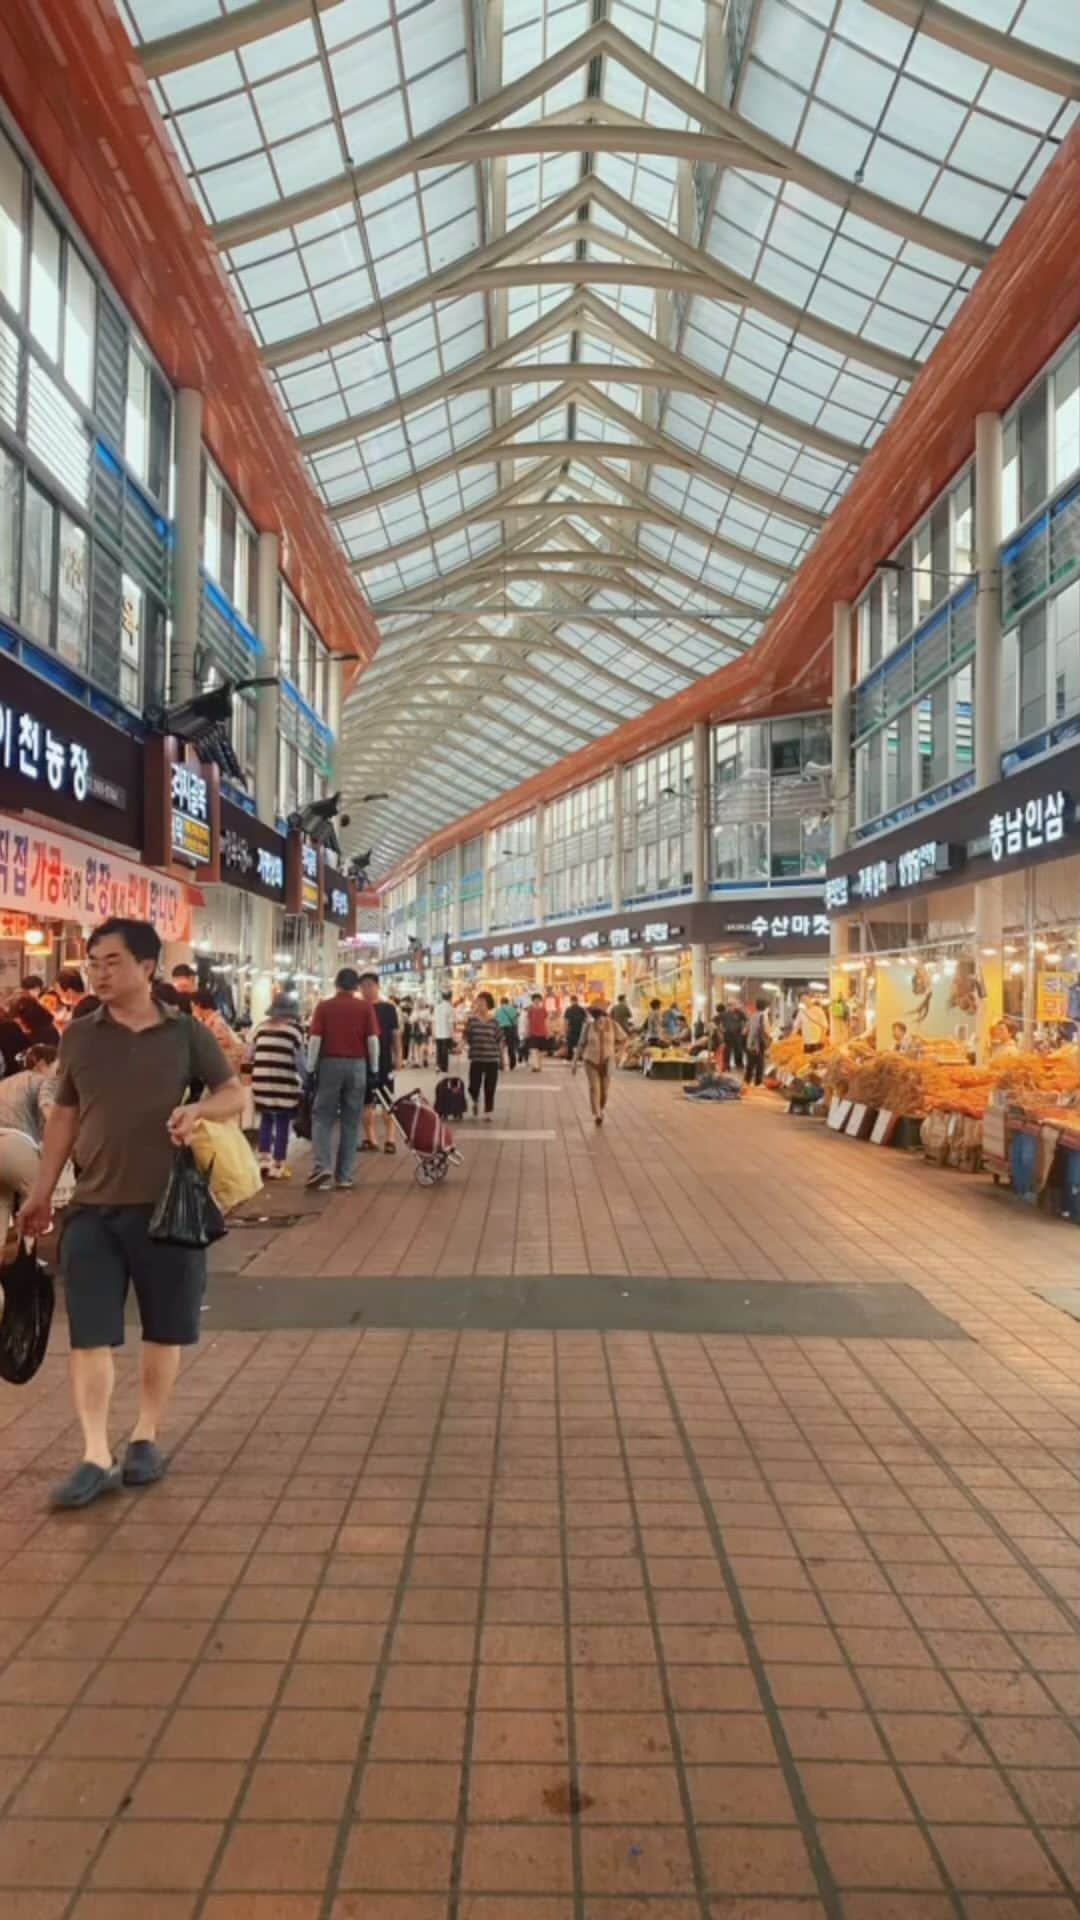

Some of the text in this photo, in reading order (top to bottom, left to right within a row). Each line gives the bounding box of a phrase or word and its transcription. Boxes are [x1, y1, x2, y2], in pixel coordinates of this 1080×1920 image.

[0, 703, 88, 800] 이천농장
[990, 791, 1065, 861] 충남인삼
[30, 840, 82, 909] 가공하여
